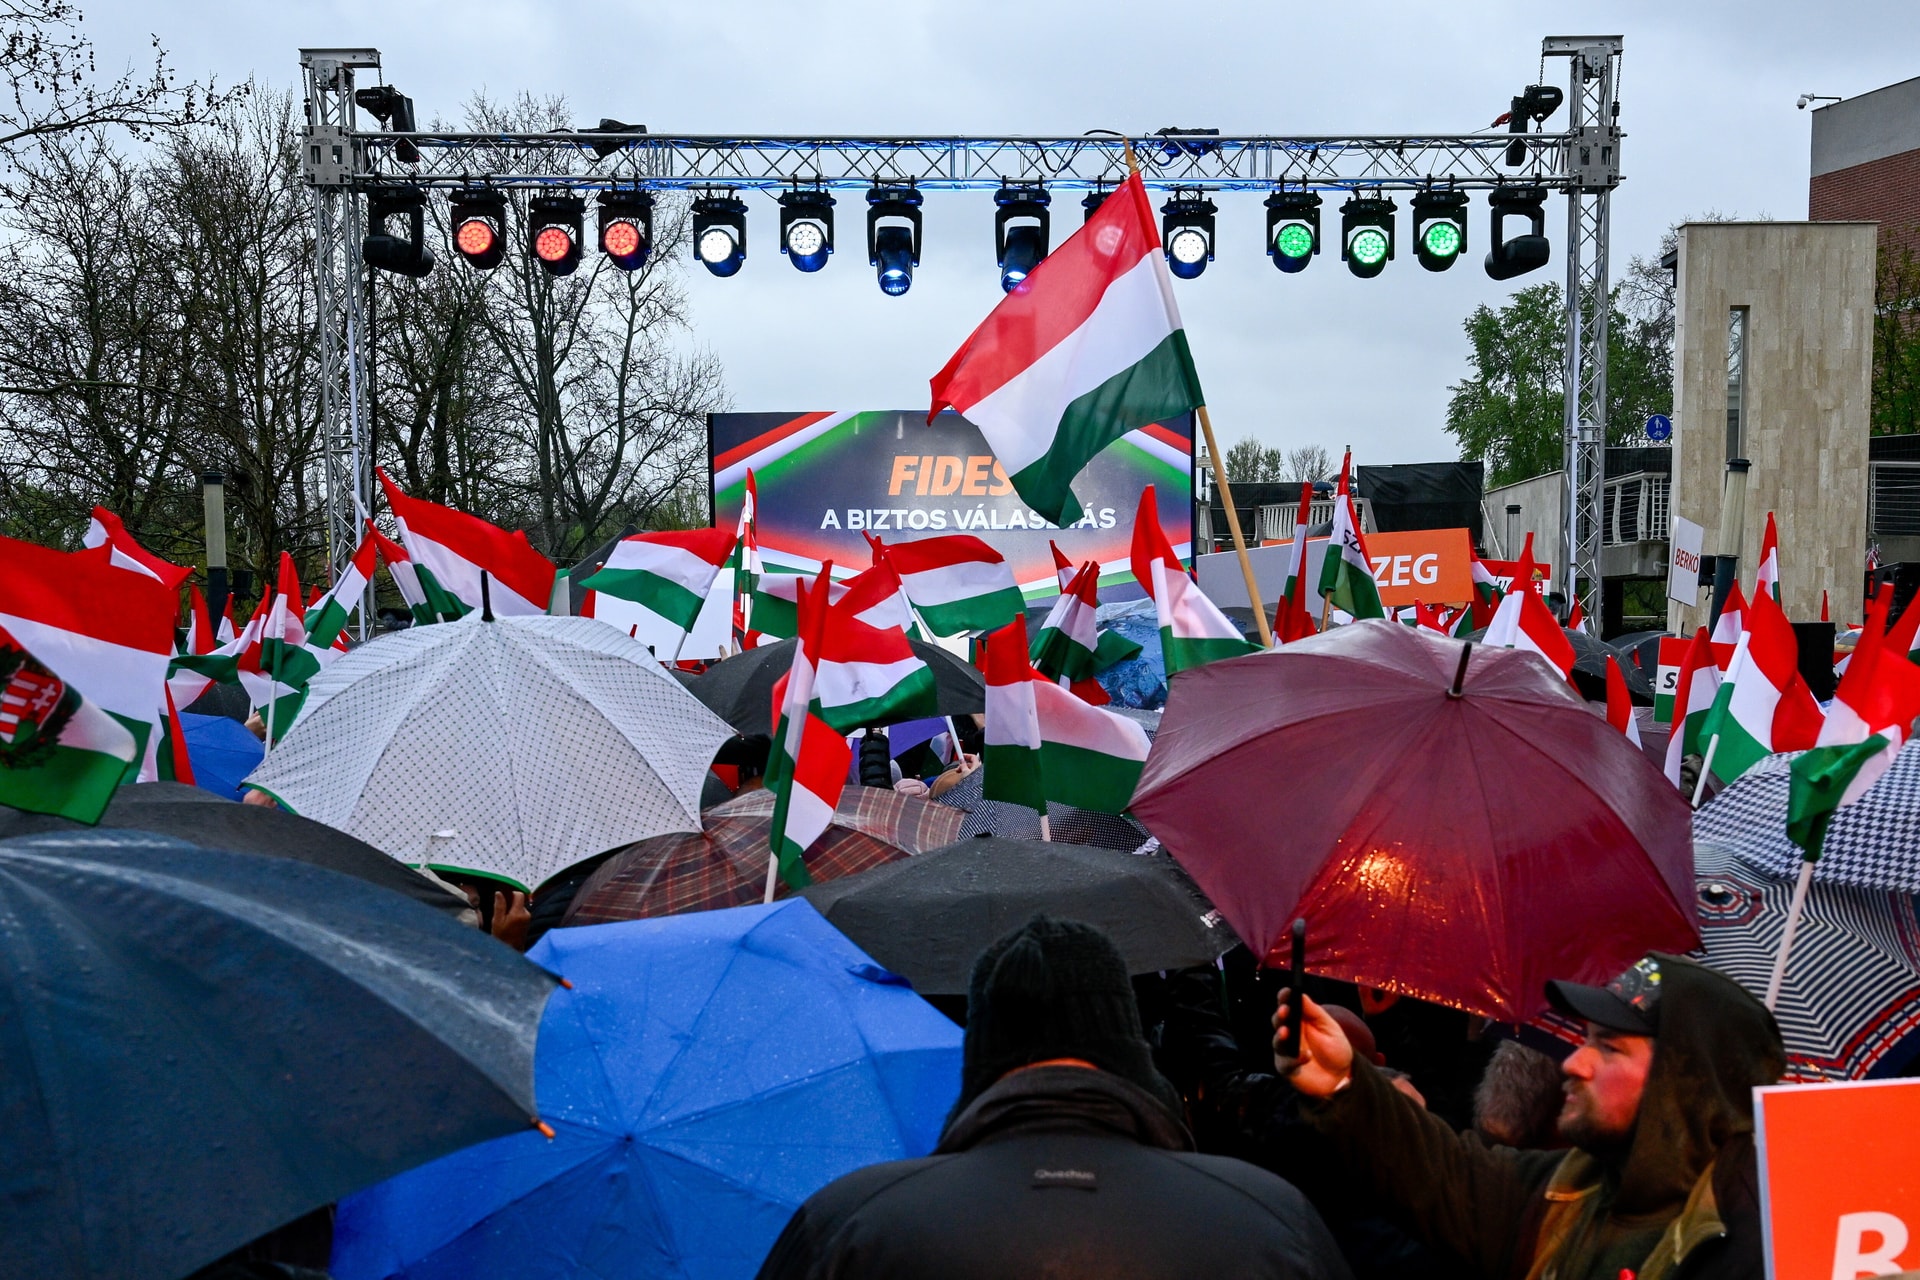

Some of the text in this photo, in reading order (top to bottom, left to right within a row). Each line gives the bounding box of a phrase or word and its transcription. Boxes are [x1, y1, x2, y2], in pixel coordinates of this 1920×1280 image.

[888, 455, 1018, 496] FIDES
[820, 503, 1117, 530] A BIZTOS VÁLASÁS
[1369, 553, 1439, 587] ZEG
[1675, 548, 1699, 573] BERKÓ
